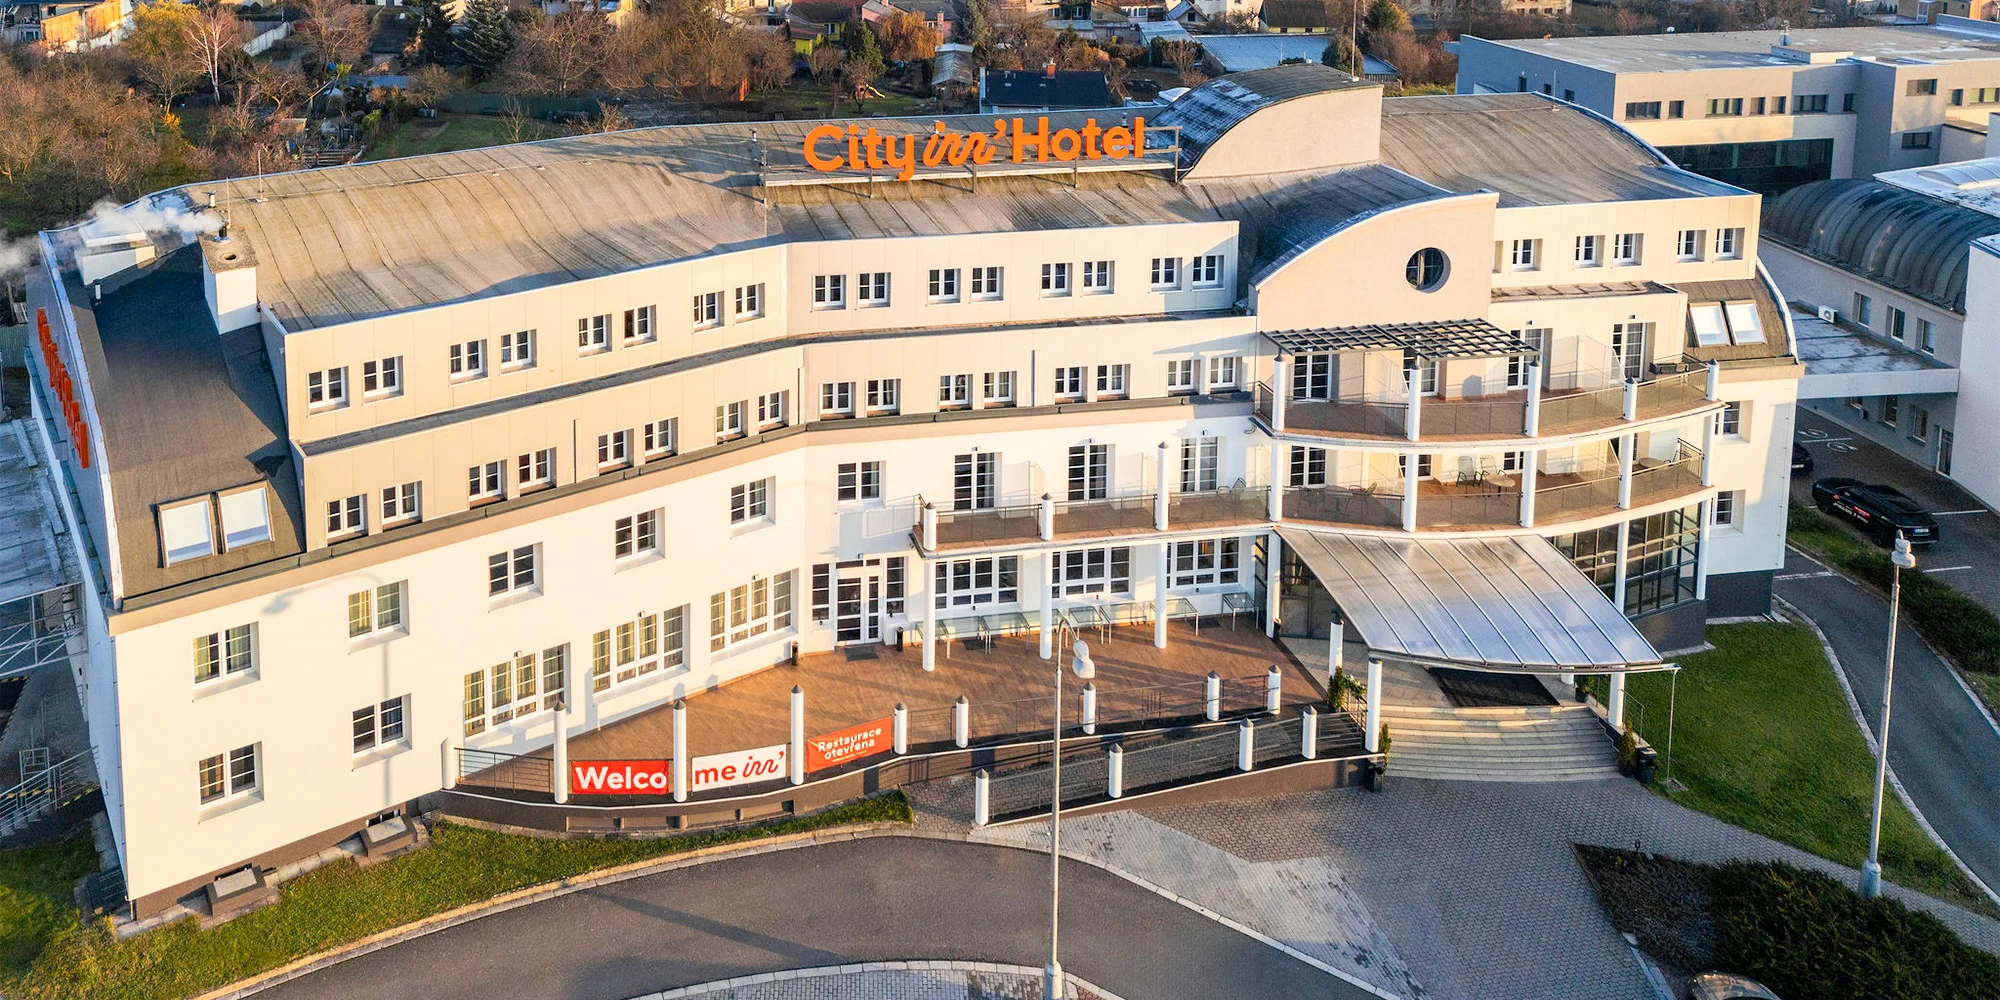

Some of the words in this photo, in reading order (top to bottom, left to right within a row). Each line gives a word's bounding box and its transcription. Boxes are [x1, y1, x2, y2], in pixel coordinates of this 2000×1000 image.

[803, 124, 915, 181] City
[1011, 116, 1145, 164] Hotel
[818, 727, 882, 752] Restaurace
[575, 765, 668, 790] Welco
[694, 764, 737, 785] me
